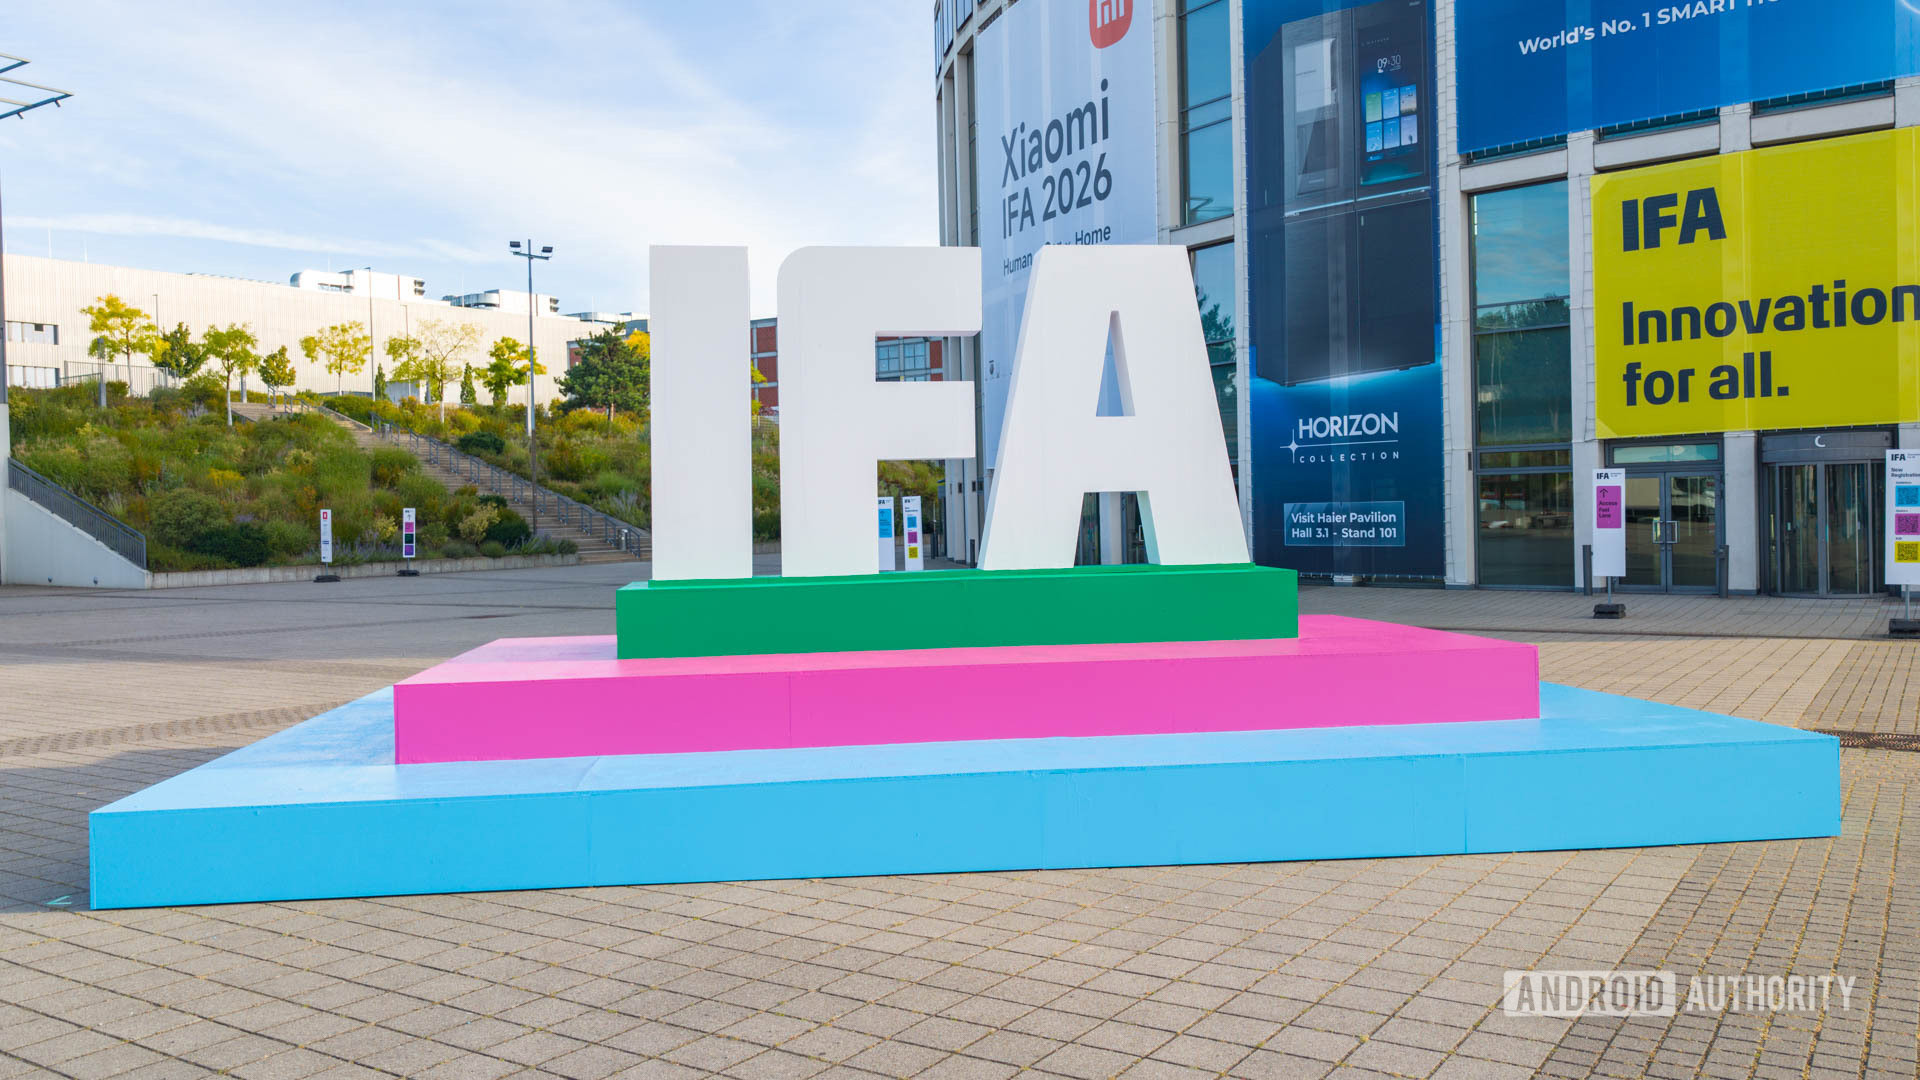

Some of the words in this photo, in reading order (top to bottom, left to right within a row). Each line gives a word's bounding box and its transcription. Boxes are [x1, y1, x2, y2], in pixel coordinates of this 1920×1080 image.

[1518, 25, 1595, 56] World's
[1601, 19, 1637, 38] No.
[1641, 12, 1651, 28] 1
[1001, 78, 1110, 188] Xiaomi
[1002, 186, 1035, 240] IFA
[1042, 152, 1113, 222] 2026
[1621, 186, 1727, 252] IFA
[1003, 252, 1033, 277] Human
[1075, 225, 1111, 245] Home
[1622, 279, 1920, 346] Innovation
[1623, 361, 1695, 407] for
[1708, 350, 1790, 401] all.
[650, 245, 1249, 581] IFA
[1298, 411, 1399, 440] HORIZON
[1299, 451, 1400, 464] COLLECTION
[1891, 453, 1906, 461] IFA
[1291, 512, 1315, 523] Visit
[1317, 511, 1347, 523] Haier
[1349, 511, 1397, 523] Pavilion
[1291, 528, 1312, 538] Hall
[1315, 528, 1329, 538] 3.1
[1341, 528, 1376, 538] Stand
[1379, 527, 1397, 538] 101
